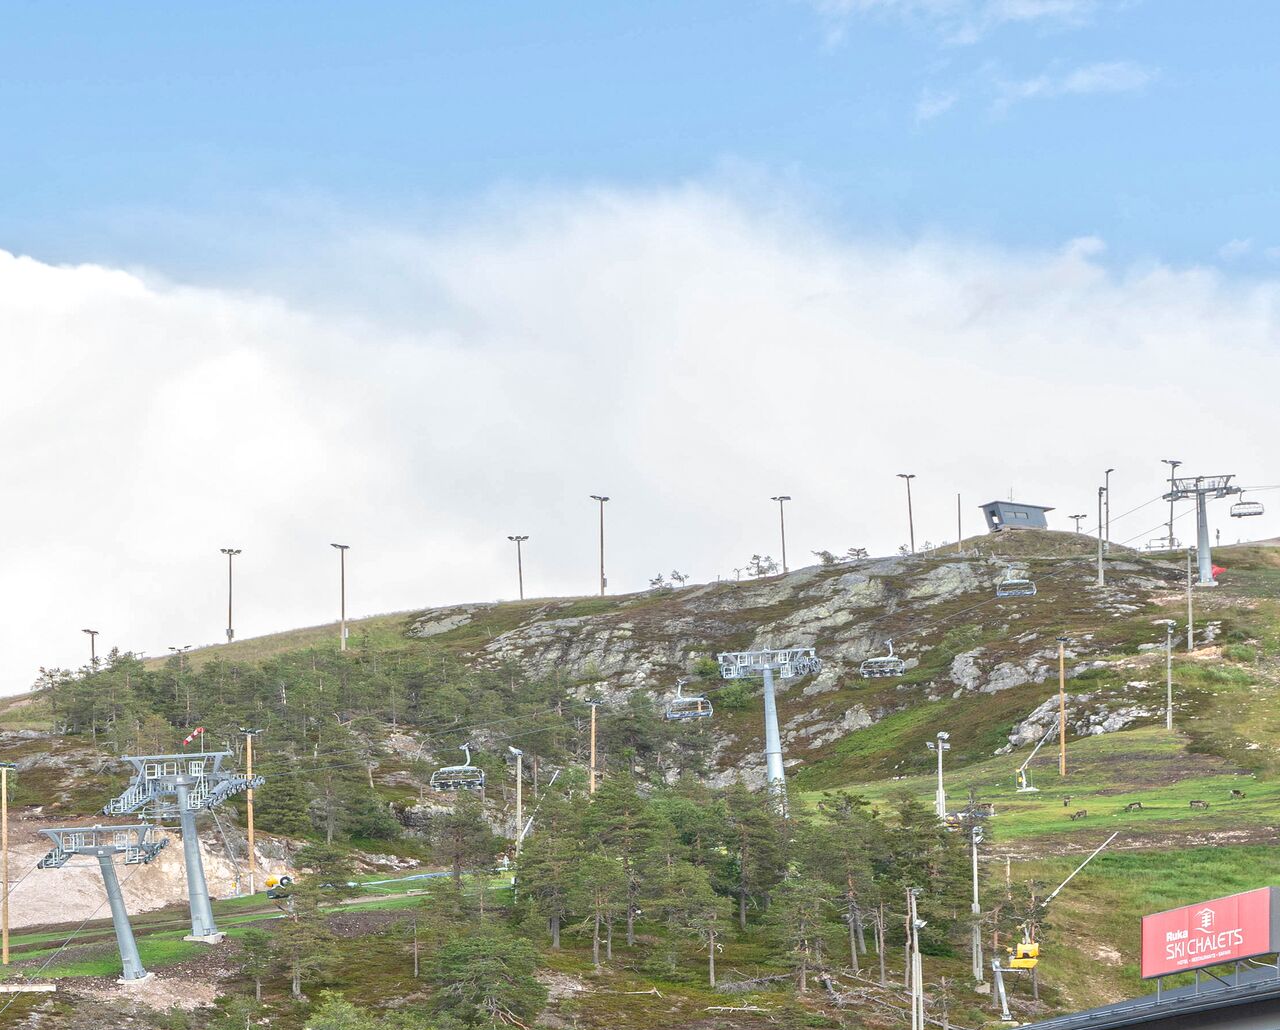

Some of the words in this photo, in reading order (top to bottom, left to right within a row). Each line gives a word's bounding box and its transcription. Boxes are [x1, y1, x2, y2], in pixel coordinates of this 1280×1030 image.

[1166, 929, 1188, 942] Ruka
[1166, 942, 1185, 960] SKI
[1187, 928, 1243, 955] CHALETS
